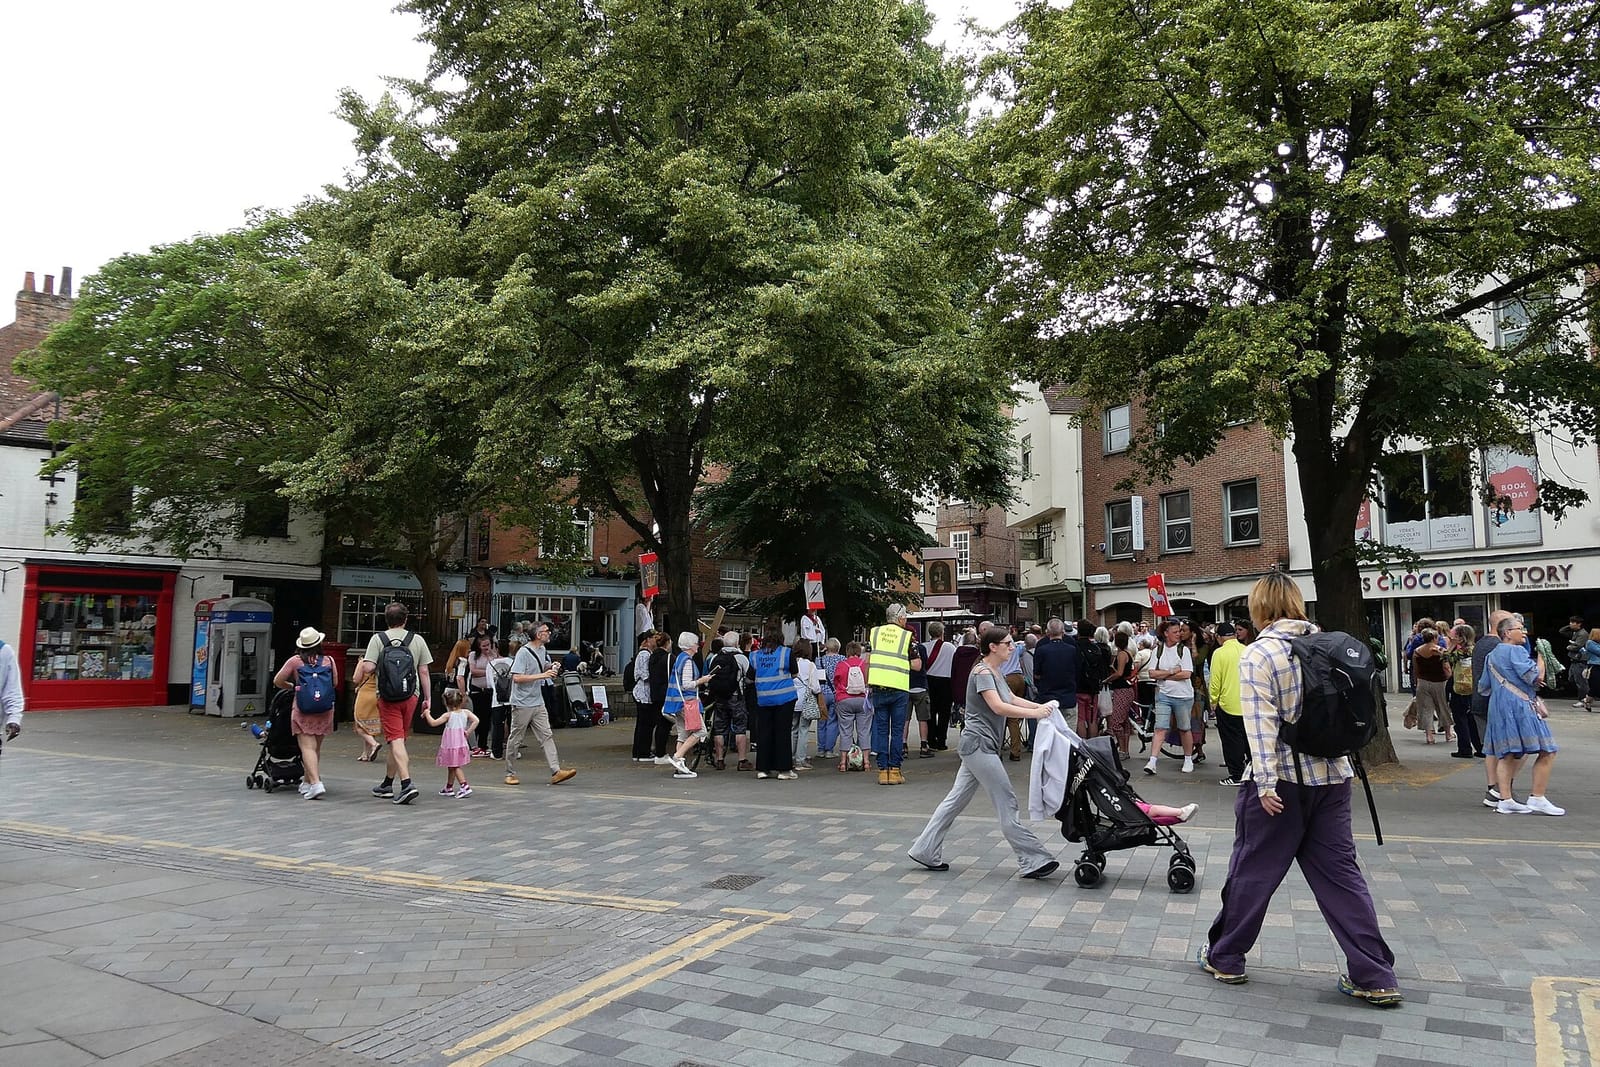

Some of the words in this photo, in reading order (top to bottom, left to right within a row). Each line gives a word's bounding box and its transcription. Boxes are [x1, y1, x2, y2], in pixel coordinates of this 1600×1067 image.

[1501, 482, 1527, 491] BOOK
[1437, 527, 1467, 535] CHOCOLATE
[1377, 569, 1496, 591] CHOCOLATE
[1503, 563, 1574, 585] STORY
